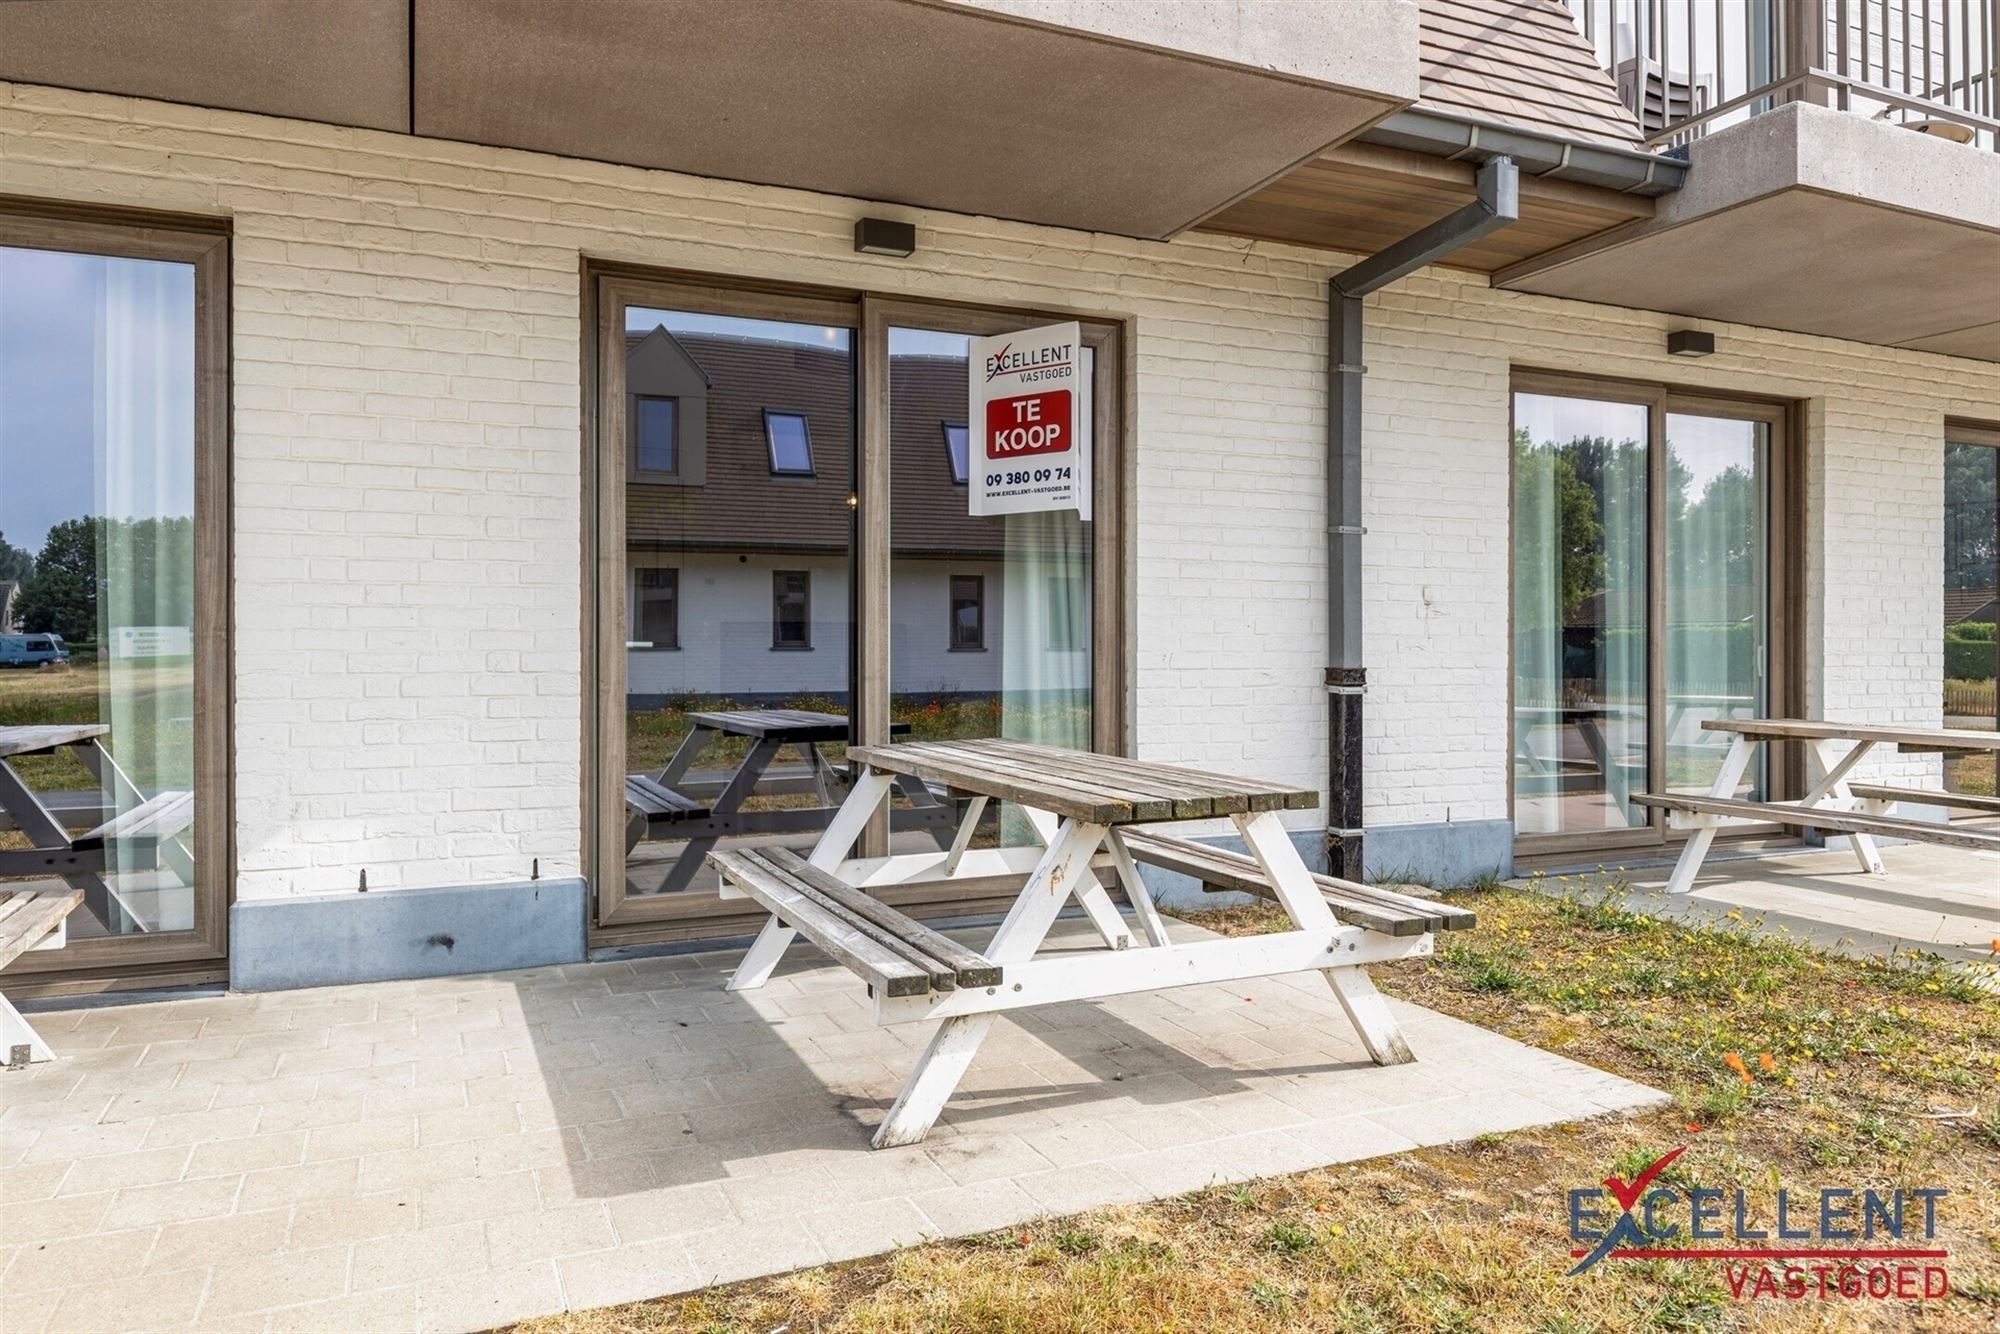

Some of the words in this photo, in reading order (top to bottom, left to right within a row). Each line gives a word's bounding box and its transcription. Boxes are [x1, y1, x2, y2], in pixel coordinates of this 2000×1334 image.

[986, 342, 1072, 383] EXCELLENT
[1020, 366, 1072, 383] VASTGOED
[1012, 399, 1041, 423] TE
[995, 424, 1061, 452] KOOP
[986, 474, 1003, 487] 09
[1006, 471, 1030, 485] 380
[1034, 468, 1051, 482] 09
[1055, 467, 1071, 480] 74
[986, 485, 1071, 497] WWW.EXCELLENT-VASTGOED.BE
